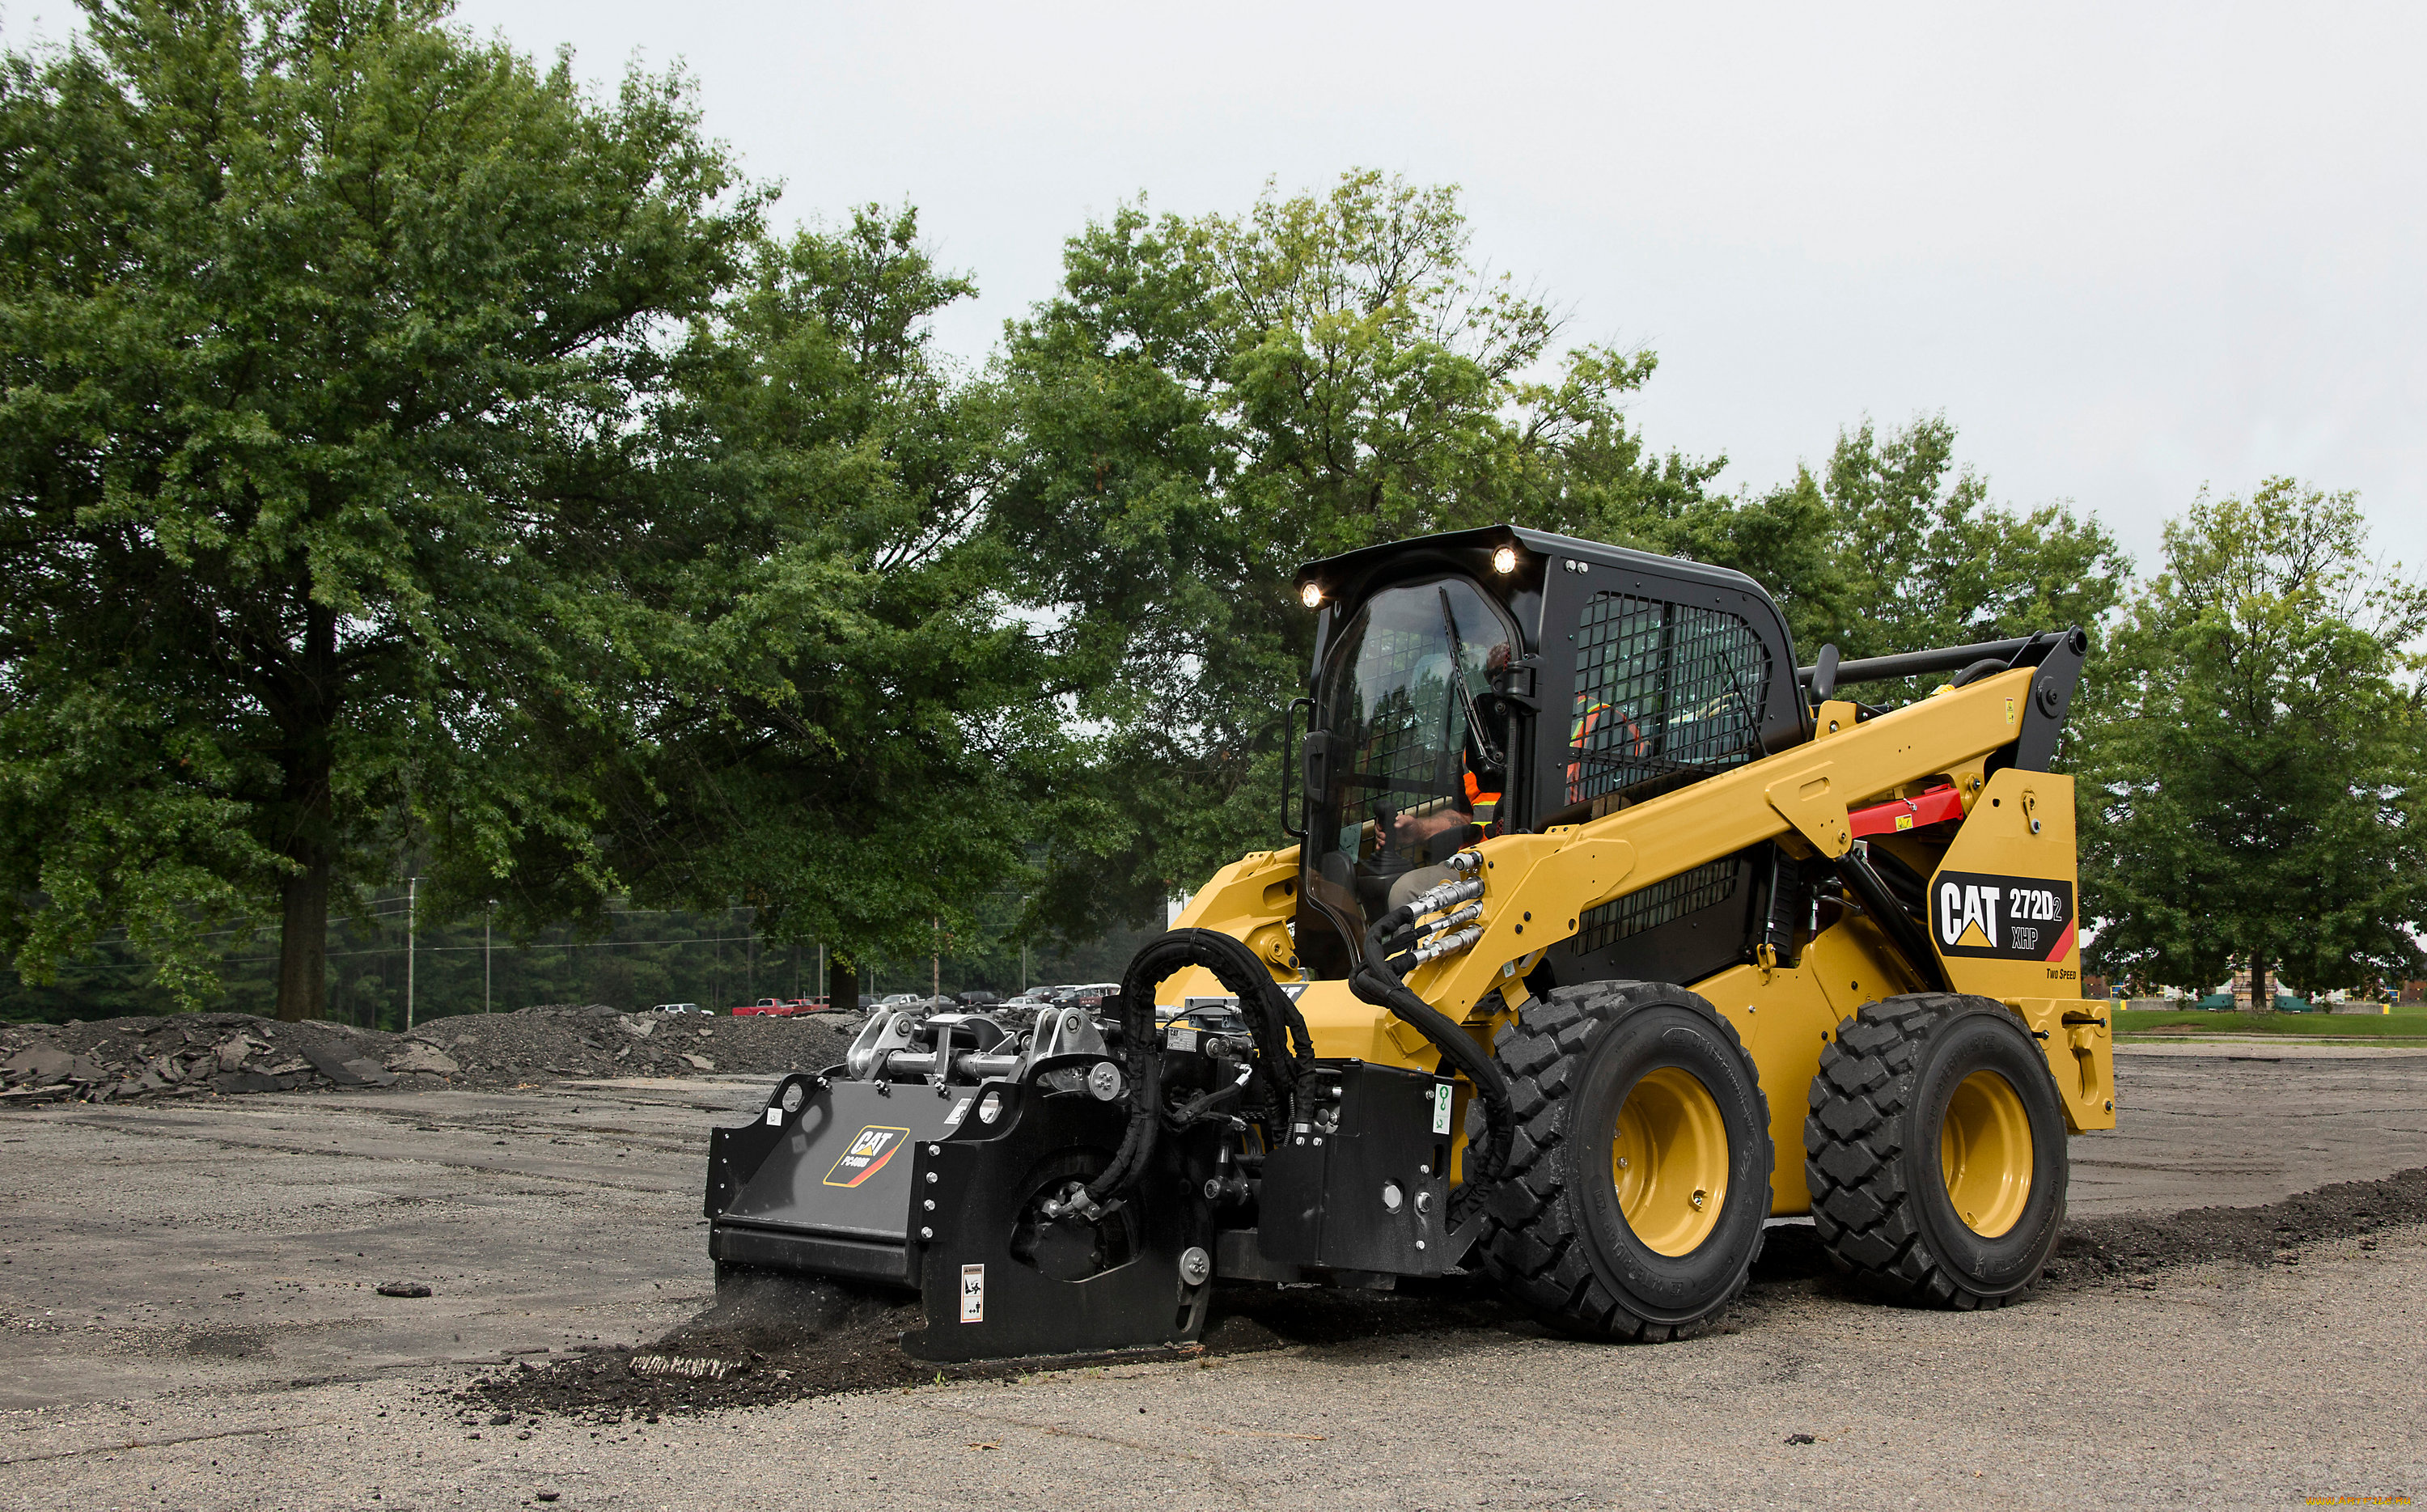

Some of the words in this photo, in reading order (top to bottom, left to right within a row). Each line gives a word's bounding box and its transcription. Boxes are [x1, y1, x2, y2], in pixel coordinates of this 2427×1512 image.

[1940, 882, 2000, 948] CAT
[2011, 926, 2039, 950] XHP
[850, 1130, 894, 1157] CAT
